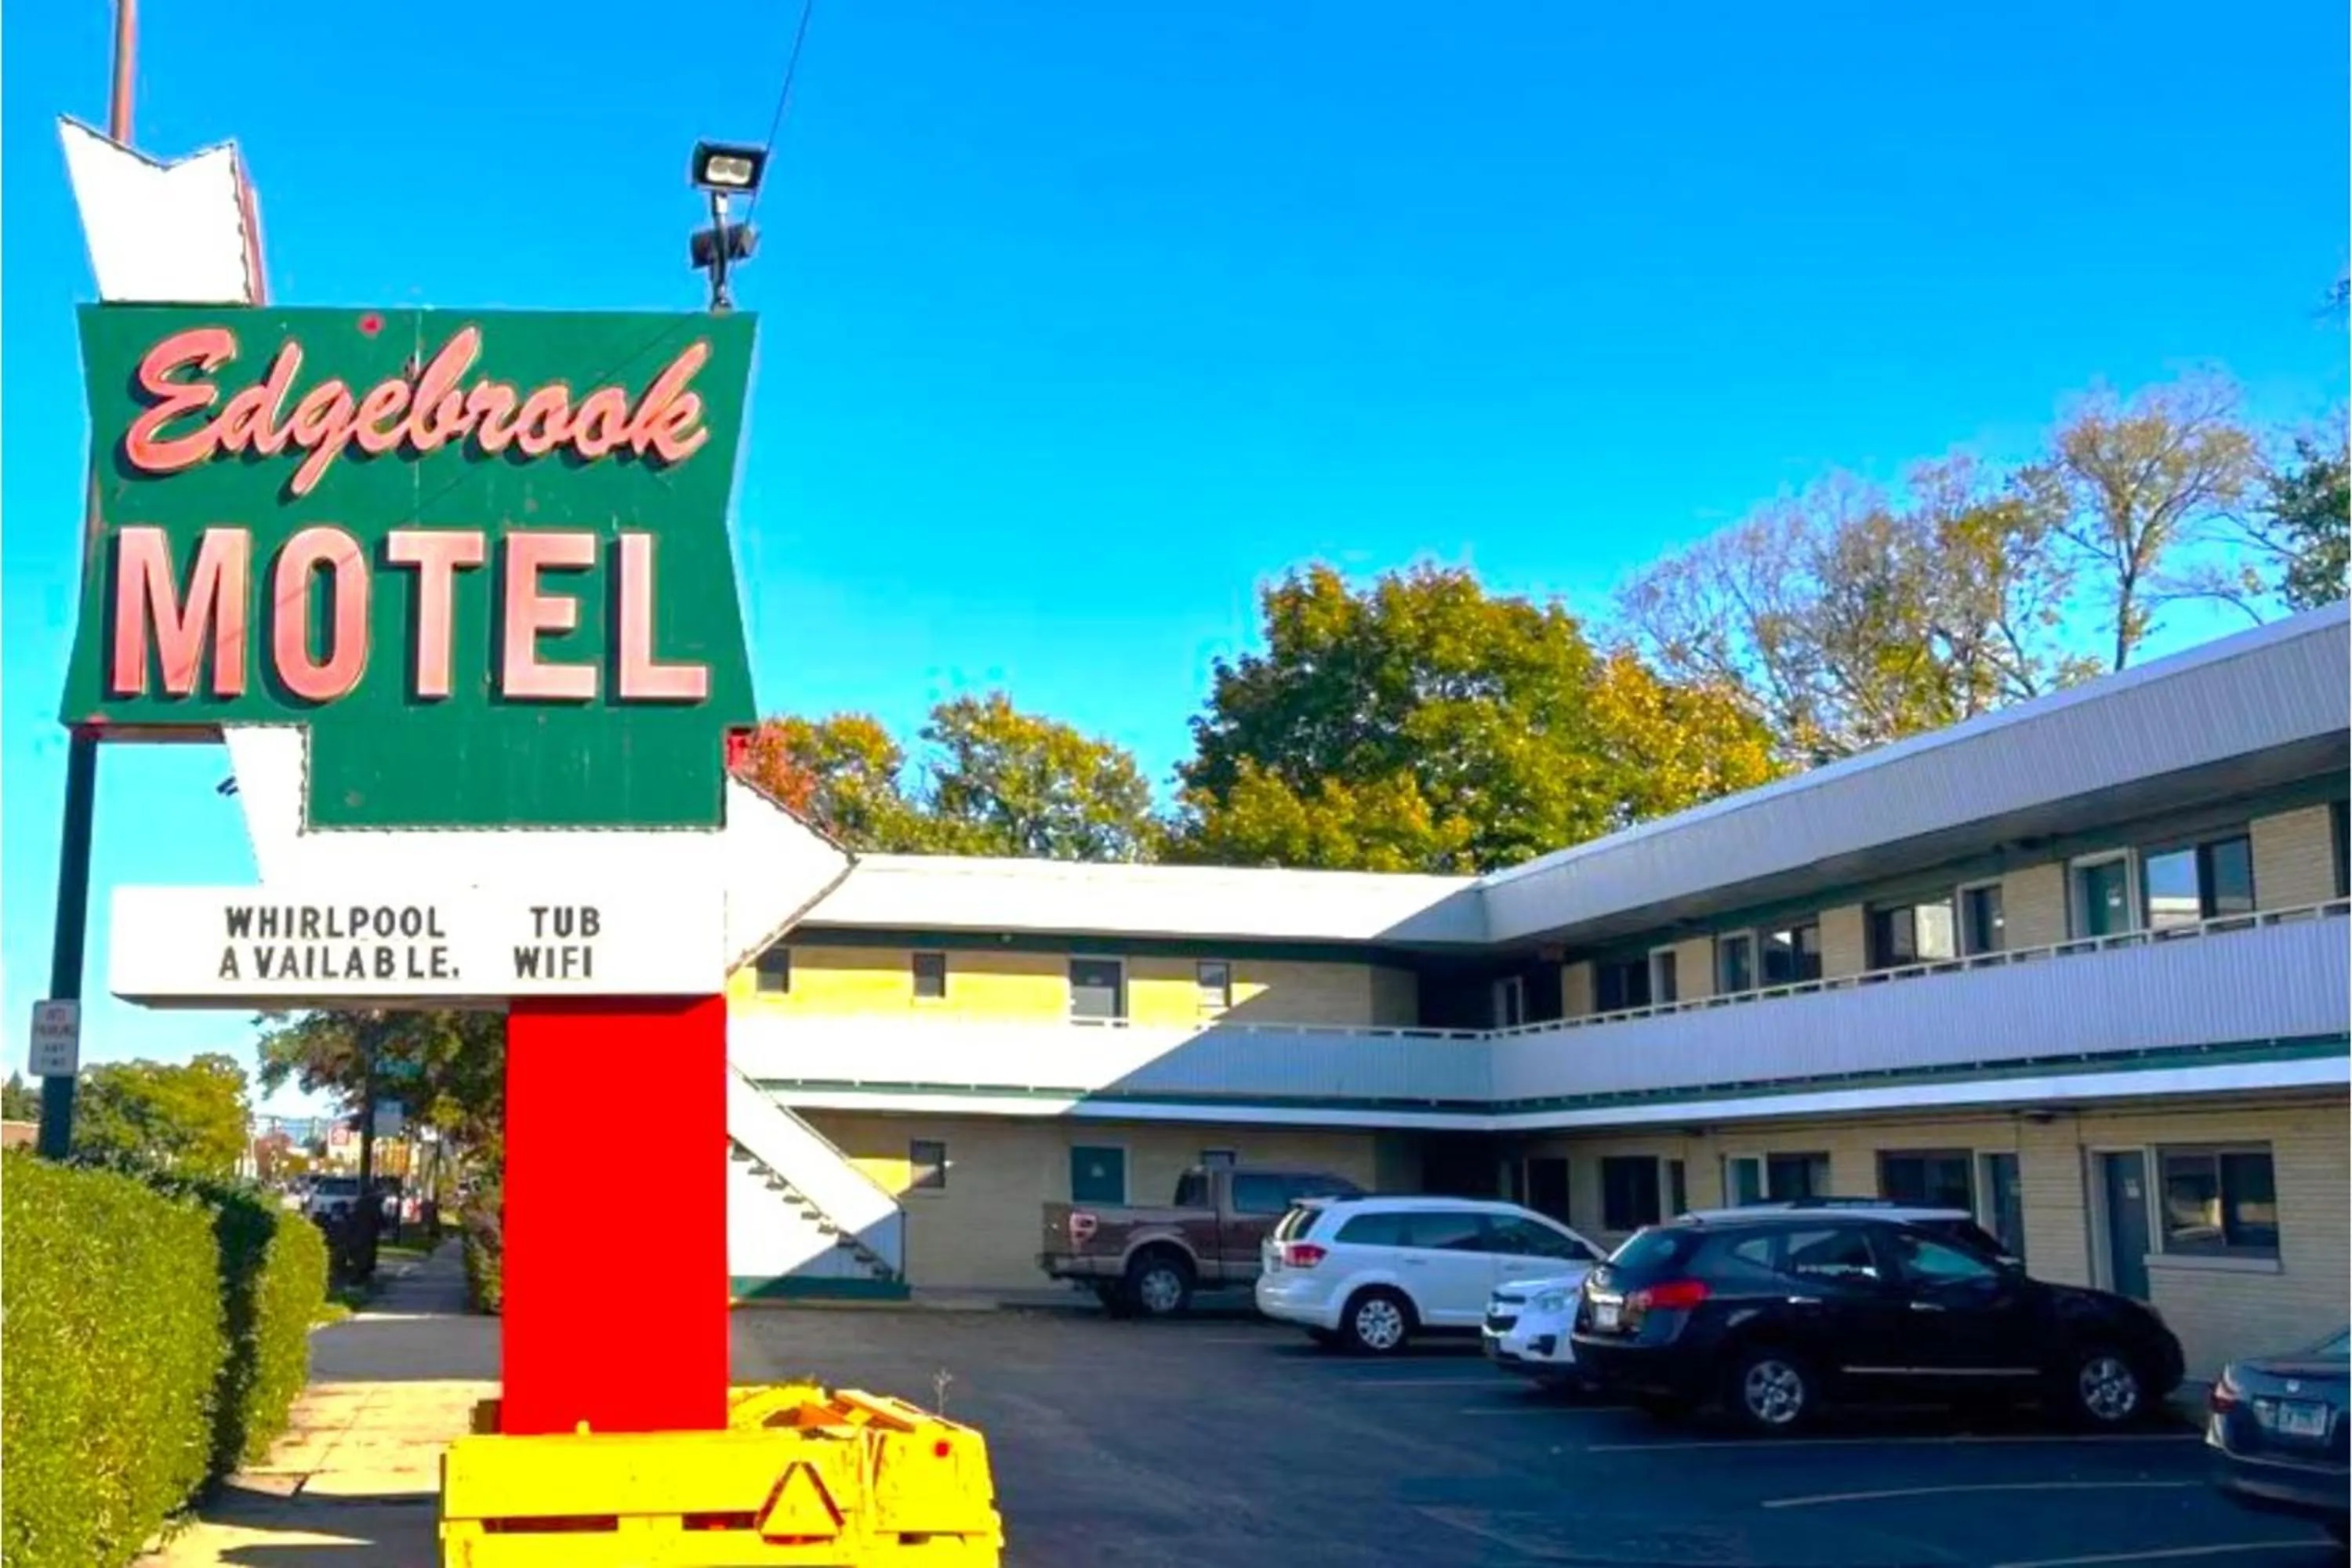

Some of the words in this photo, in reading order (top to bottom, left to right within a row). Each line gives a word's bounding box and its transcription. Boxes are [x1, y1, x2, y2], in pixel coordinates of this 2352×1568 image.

[123, 325, 710, 497] Edgebrook
[112, 525, 710, 699] MOTEL
[225, 906, 447, 939] WHIRLPOOL
[529, 906, 601, 938] TUB
[514, 946, 593, 978] WIFI
